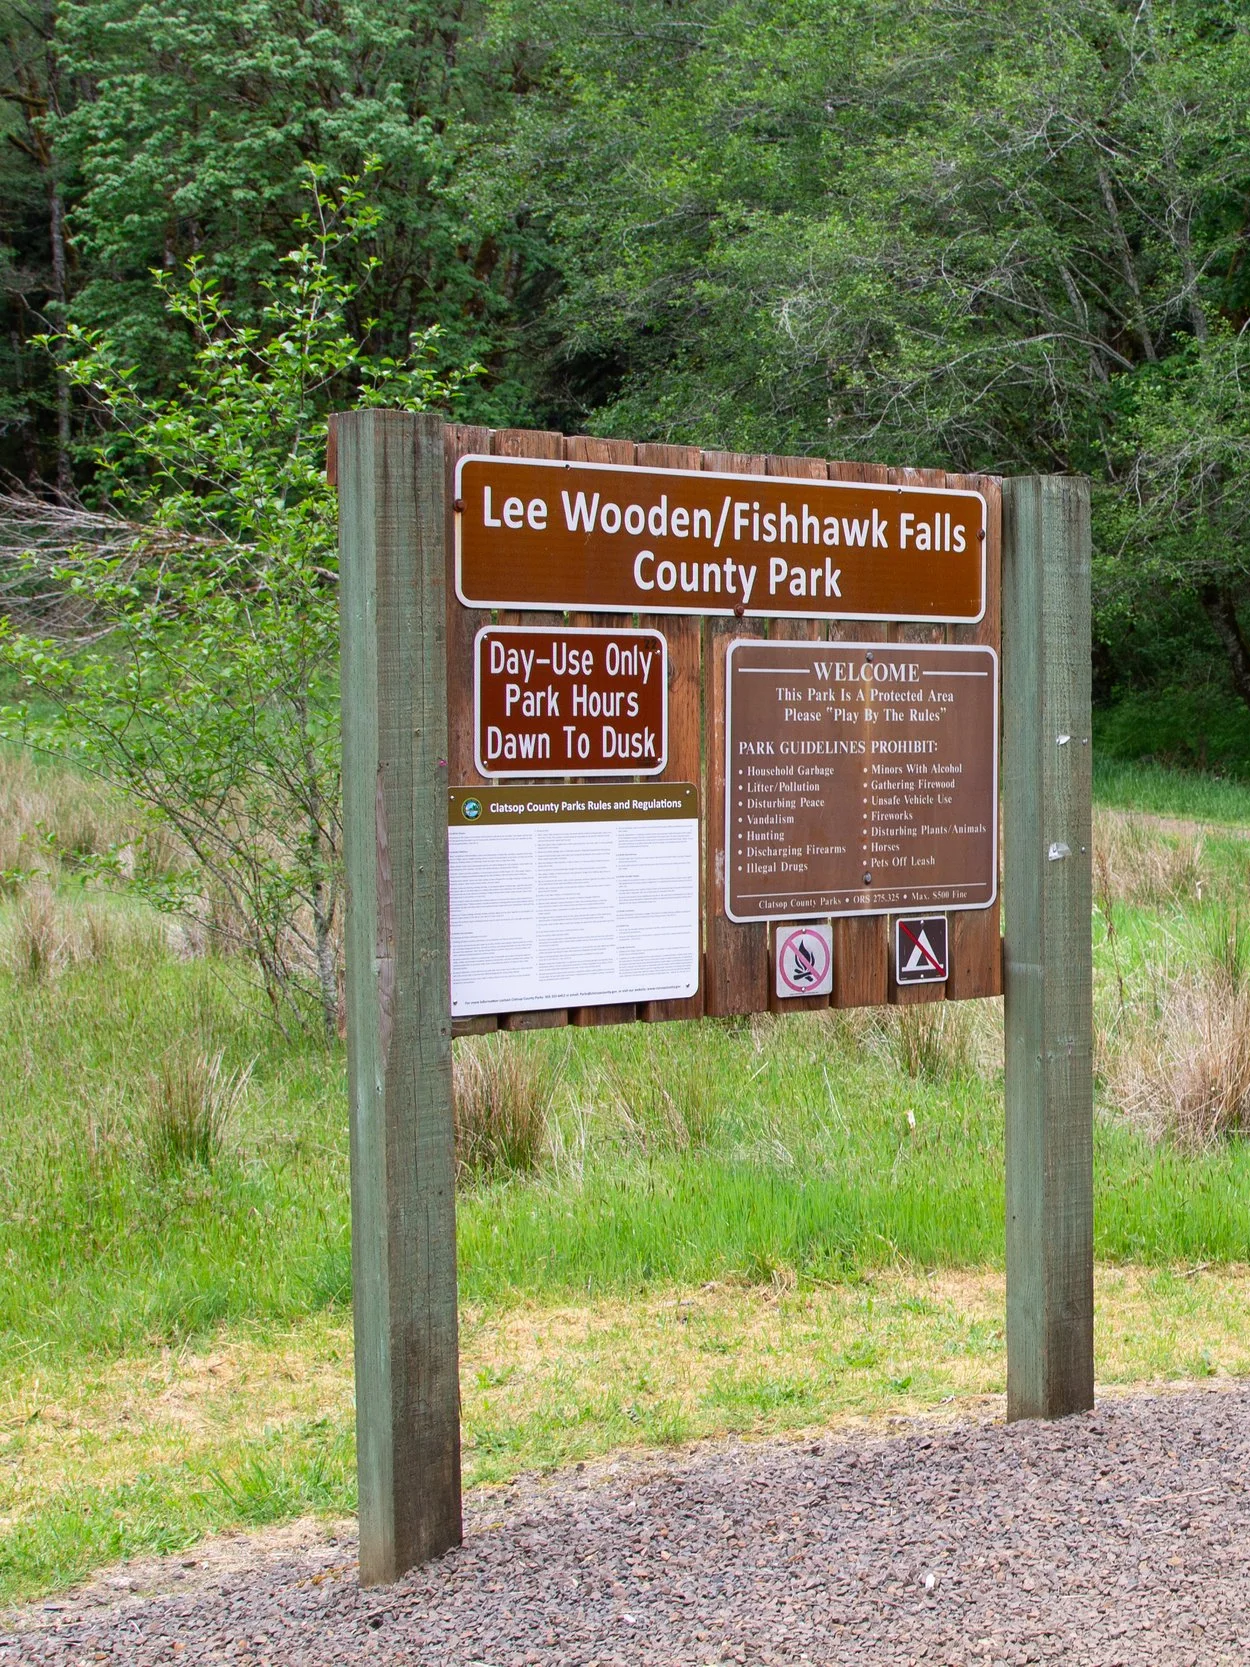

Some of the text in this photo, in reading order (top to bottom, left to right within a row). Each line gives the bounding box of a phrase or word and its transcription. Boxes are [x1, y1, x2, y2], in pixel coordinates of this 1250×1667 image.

[483, 485, 966, 554] Lee Wooden/Fishhawk Falls
[634, 550, 842, 603] County Park
[489, 641, 653, 684] Day-Use Only
[814, 662, 920, 682] WELCOME
[505, 683, 639, 718] Park Hours
[776, 688, 954, 702] This Park Is A Protected Area
[784, 708, 821, 722] Please
[864, 708, 879, 723] By
[884, 708, 904, 722] The
[487, 725, 655, 760] Dawn To Dusk
[739, 741, 938, 754] PARK GUIDELINES PROHIBIT:
[748, 765, 834, 777] Household Garbage
[872, 764, 962, 774] Minors With Alcohol
[748, 782, 820, 792] Litter/Pollution
[871, 779, 955, 790] Gathering Firewood
[490, 799, 682, 814] Clatsop County Parks Rules and Regulations
[748, 798, 824, 810] Disturbing Peace
[871, 794, 952, 806] Unsafe Vehicle Use
[748, 814, 794, 825] Vandalism
[871, 811, 913, 821] Fireworks
[747, 830, 784, 842] Hunting
[871, 824, 986, 837] Disturbing Plants/Animals
[747, 844, 846, 858] Discharging Firearms
[871, 842, 900, 852] Horses
[747, 862, 808, 874] Illegal Drugs
[871, 856, 935, 868] Pets Off Leash
[759, 900, 787, 909] Clatsop
[791, 899, 816, 907] County
[820, 897, 841, 906] Parks
[853, 895, 870, 903] ORS
[953, 890, 967, 899] Fine
